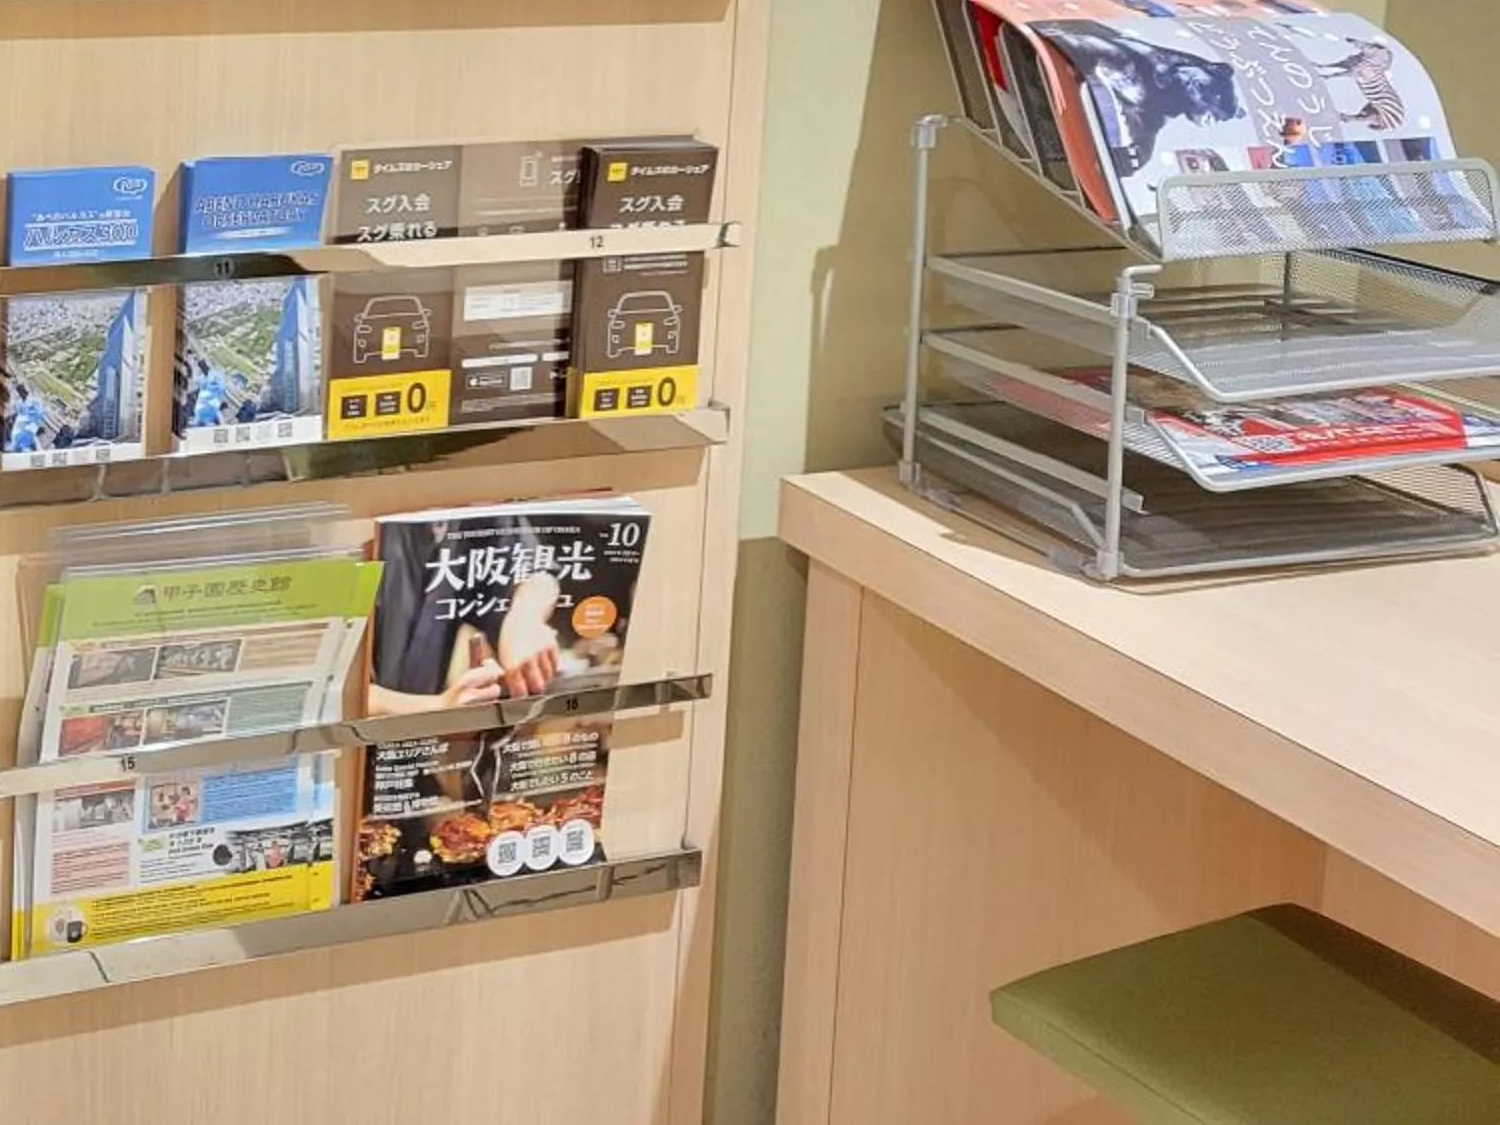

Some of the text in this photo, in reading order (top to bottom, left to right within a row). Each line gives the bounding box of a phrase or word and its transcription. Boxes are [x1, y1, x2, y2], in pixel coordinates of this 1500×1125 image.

[367, 193, 431, 214] スグ入会
[619, 194, 684, 213] スグ入会
[356, 221, 437, 243] スグ乗れる
[589, 235, 604, 249] 12
[216, 260, 230, 274] 11
[407, 382, 426, 413] 0
[658, 377, 676, 407] 0
[607, 523, 641, 547] 10
[425, 541, 596, 594] 大阪観光
[435, 593, 575, 620] コンシェュ
[565, 699, 579, 712] 16
[119, 757, 136, 772] 15
